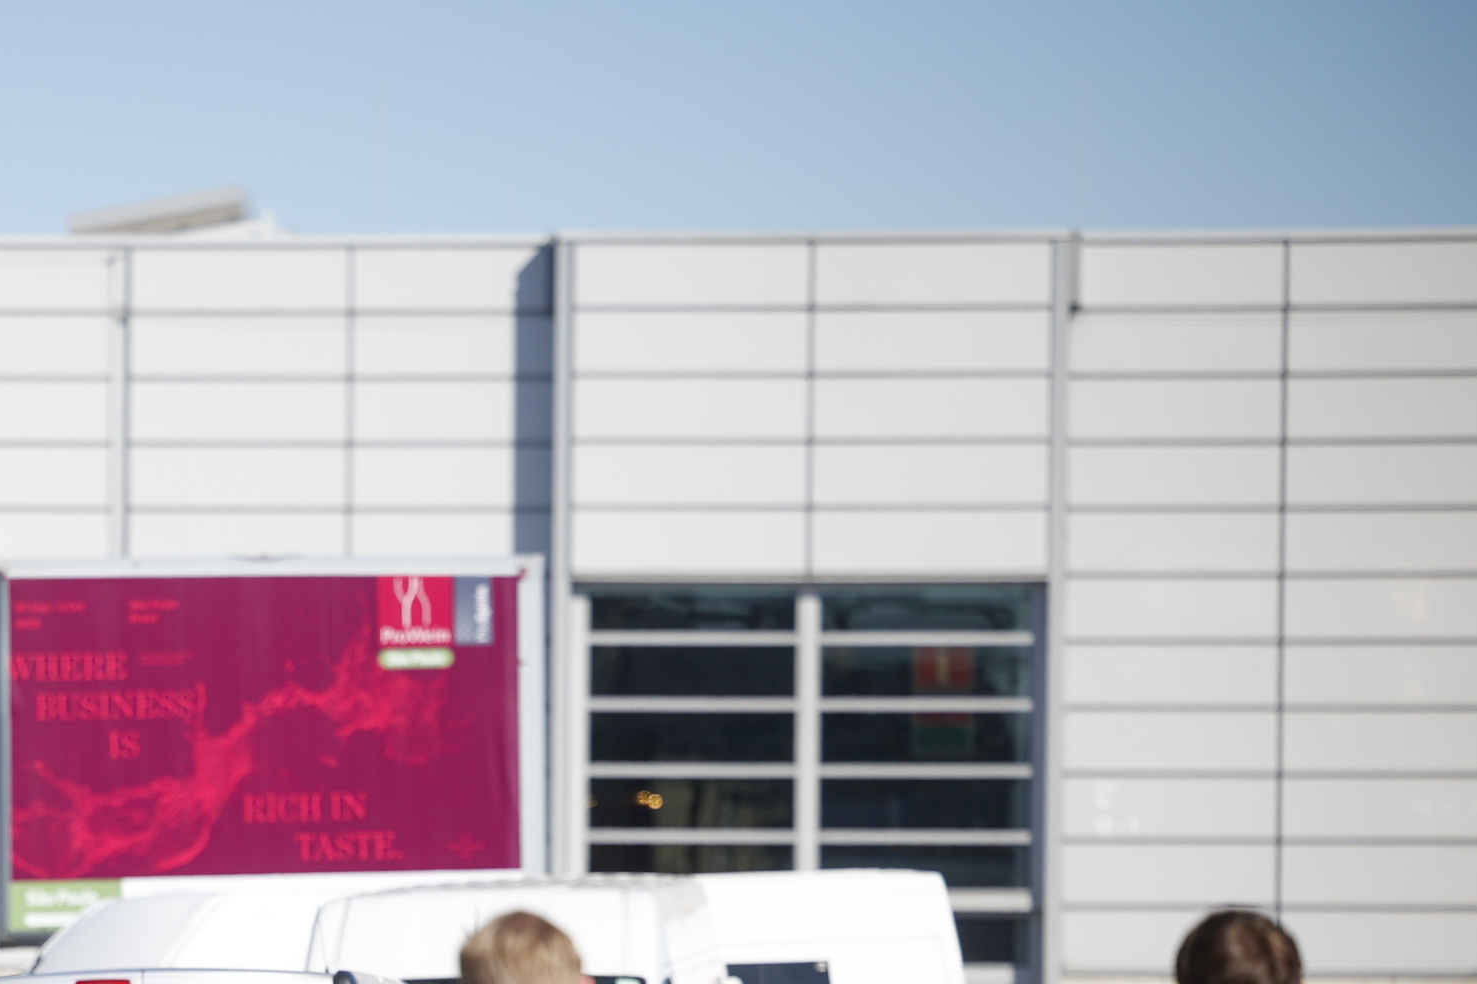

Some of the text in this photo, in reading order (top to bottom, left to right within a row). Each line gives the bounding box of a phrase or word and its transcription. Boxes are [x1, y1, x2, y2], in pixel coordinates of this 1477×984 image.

[9, 651, 129, 682] WHERE
[108, 730, 142, 760] IS
[242, 790, 368, 824] RICH IN
